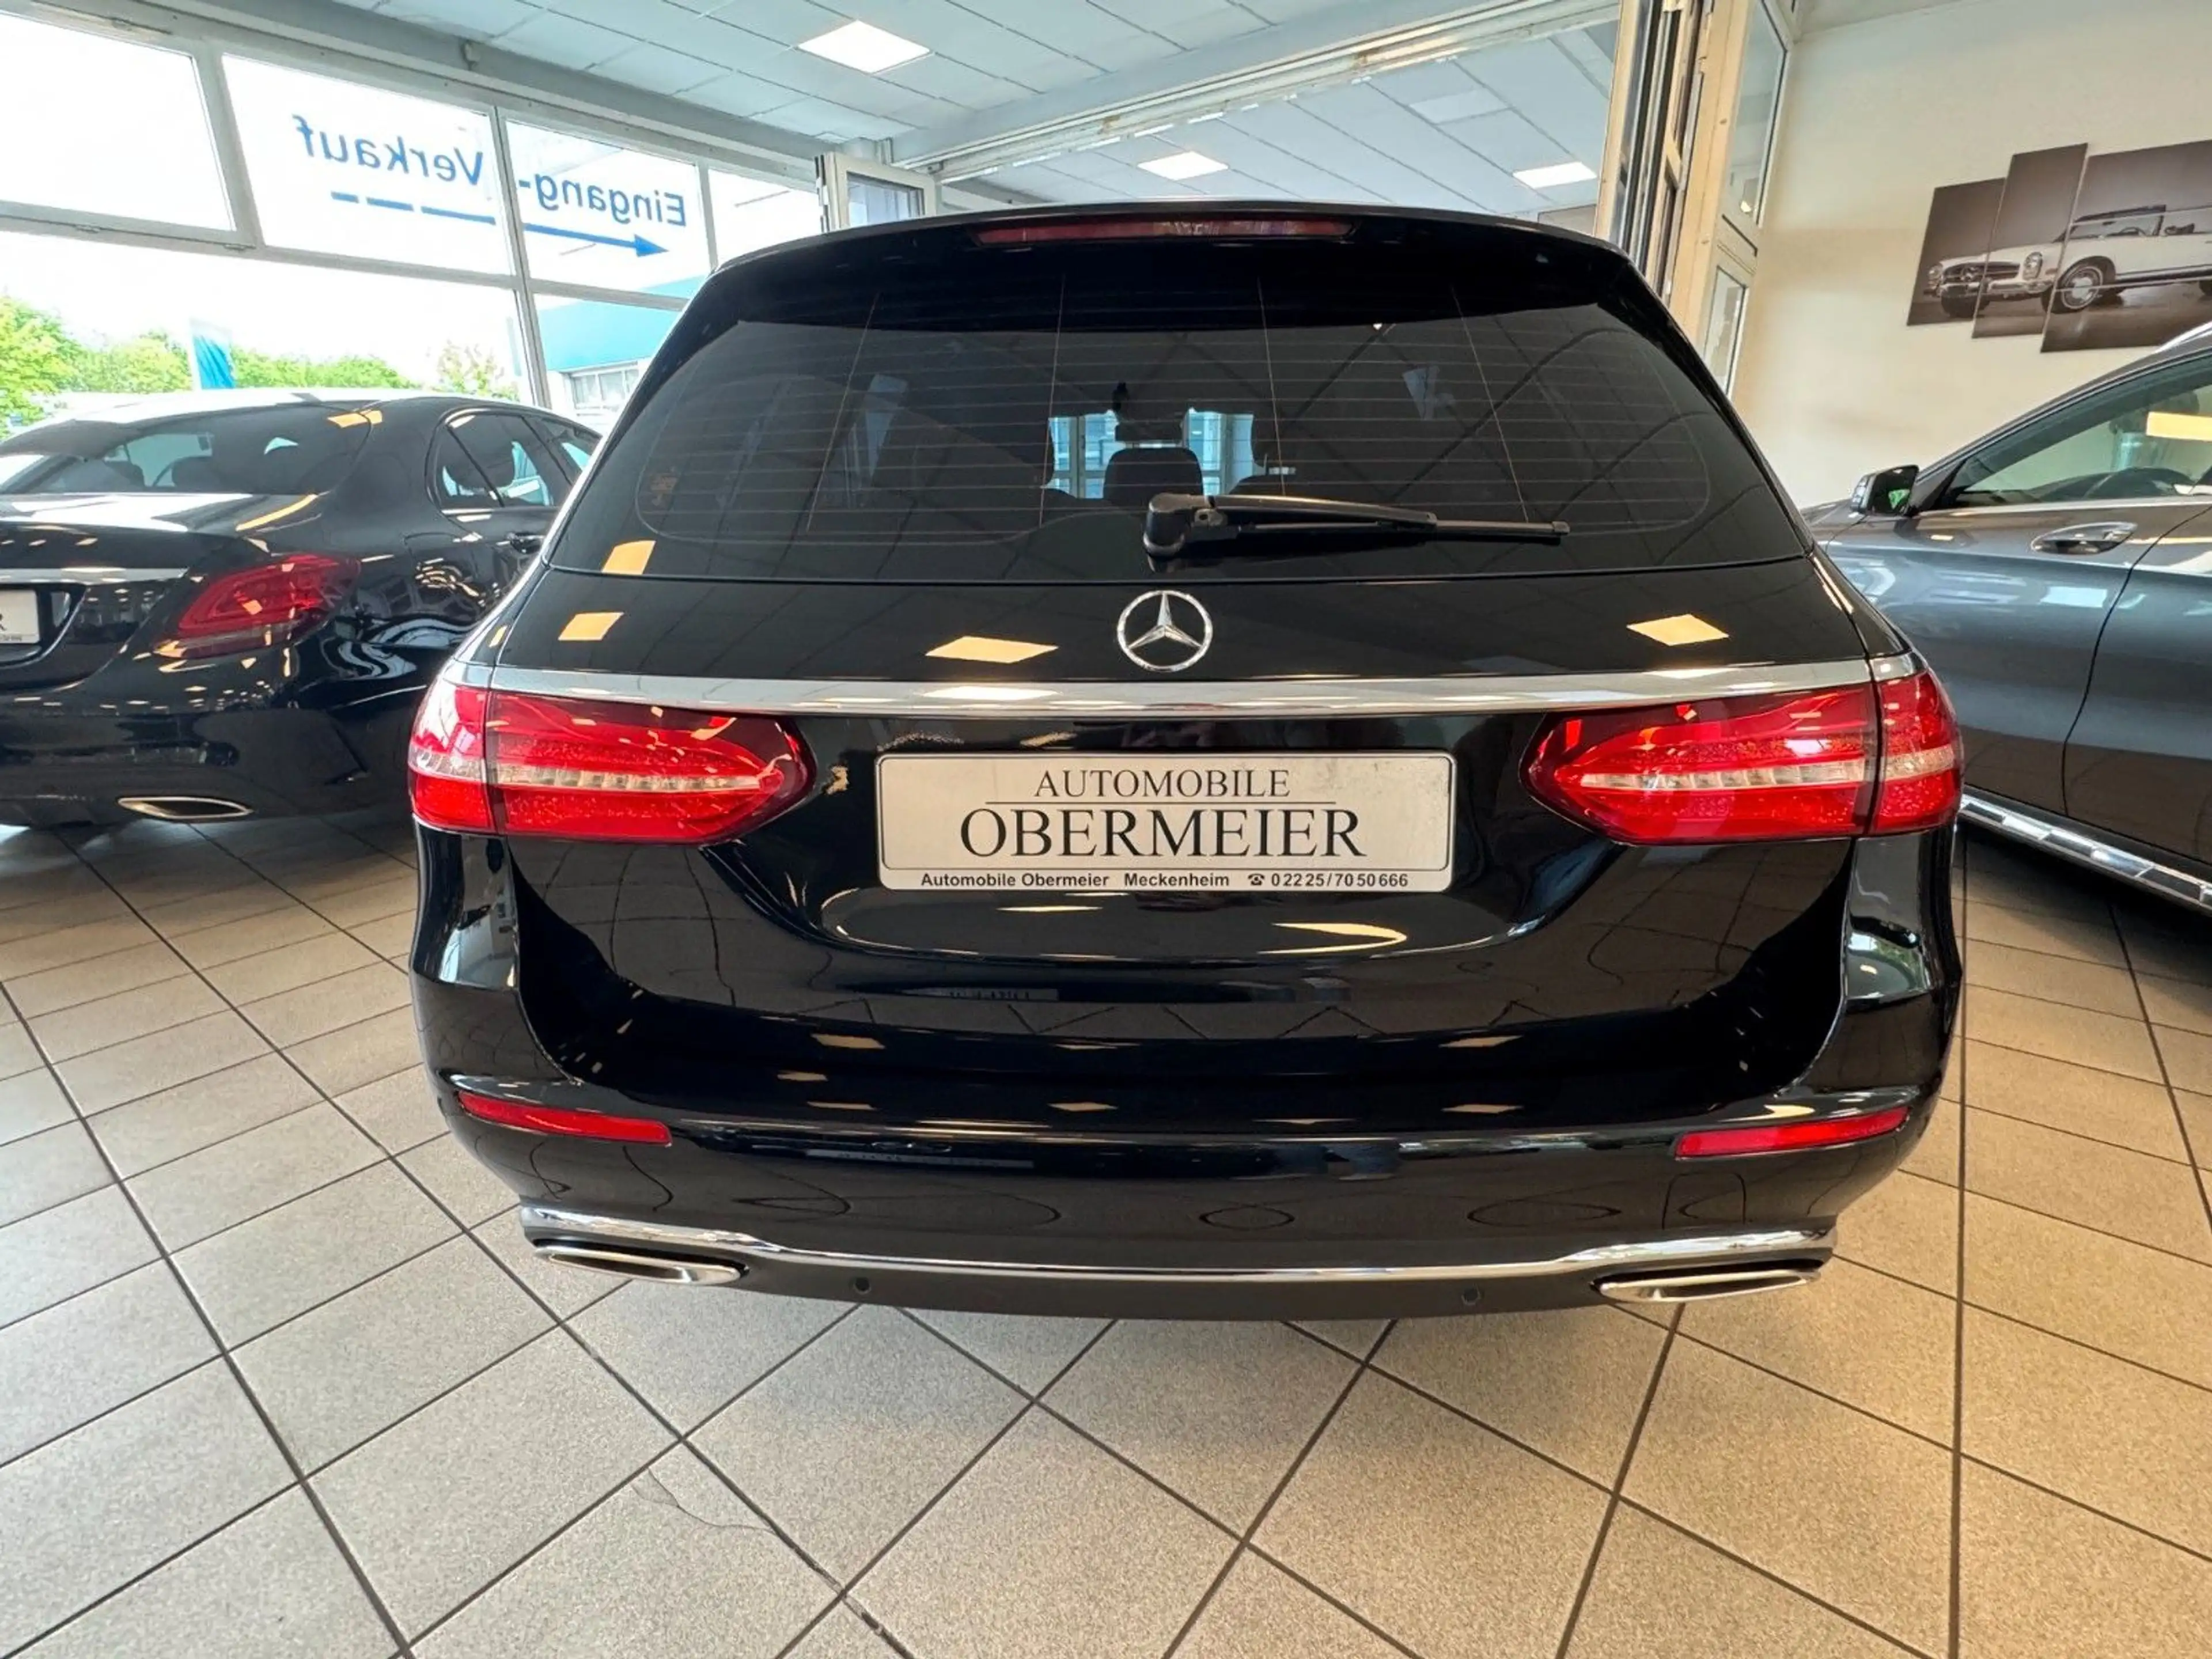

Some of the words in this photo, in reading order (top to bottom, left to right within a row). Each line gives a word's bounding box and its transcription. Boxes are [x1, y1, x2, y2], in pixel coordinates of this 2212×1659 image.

[1034, 769, 1290, 798] AUTOMOBILE
[960, 808, 1367, 858] OBERMEIER
[921, 872, 1016, 888] Automobile
[1021, 872, 1109, 888] Obermeier
[1124, 872, 1230, 888] Meckenheim
